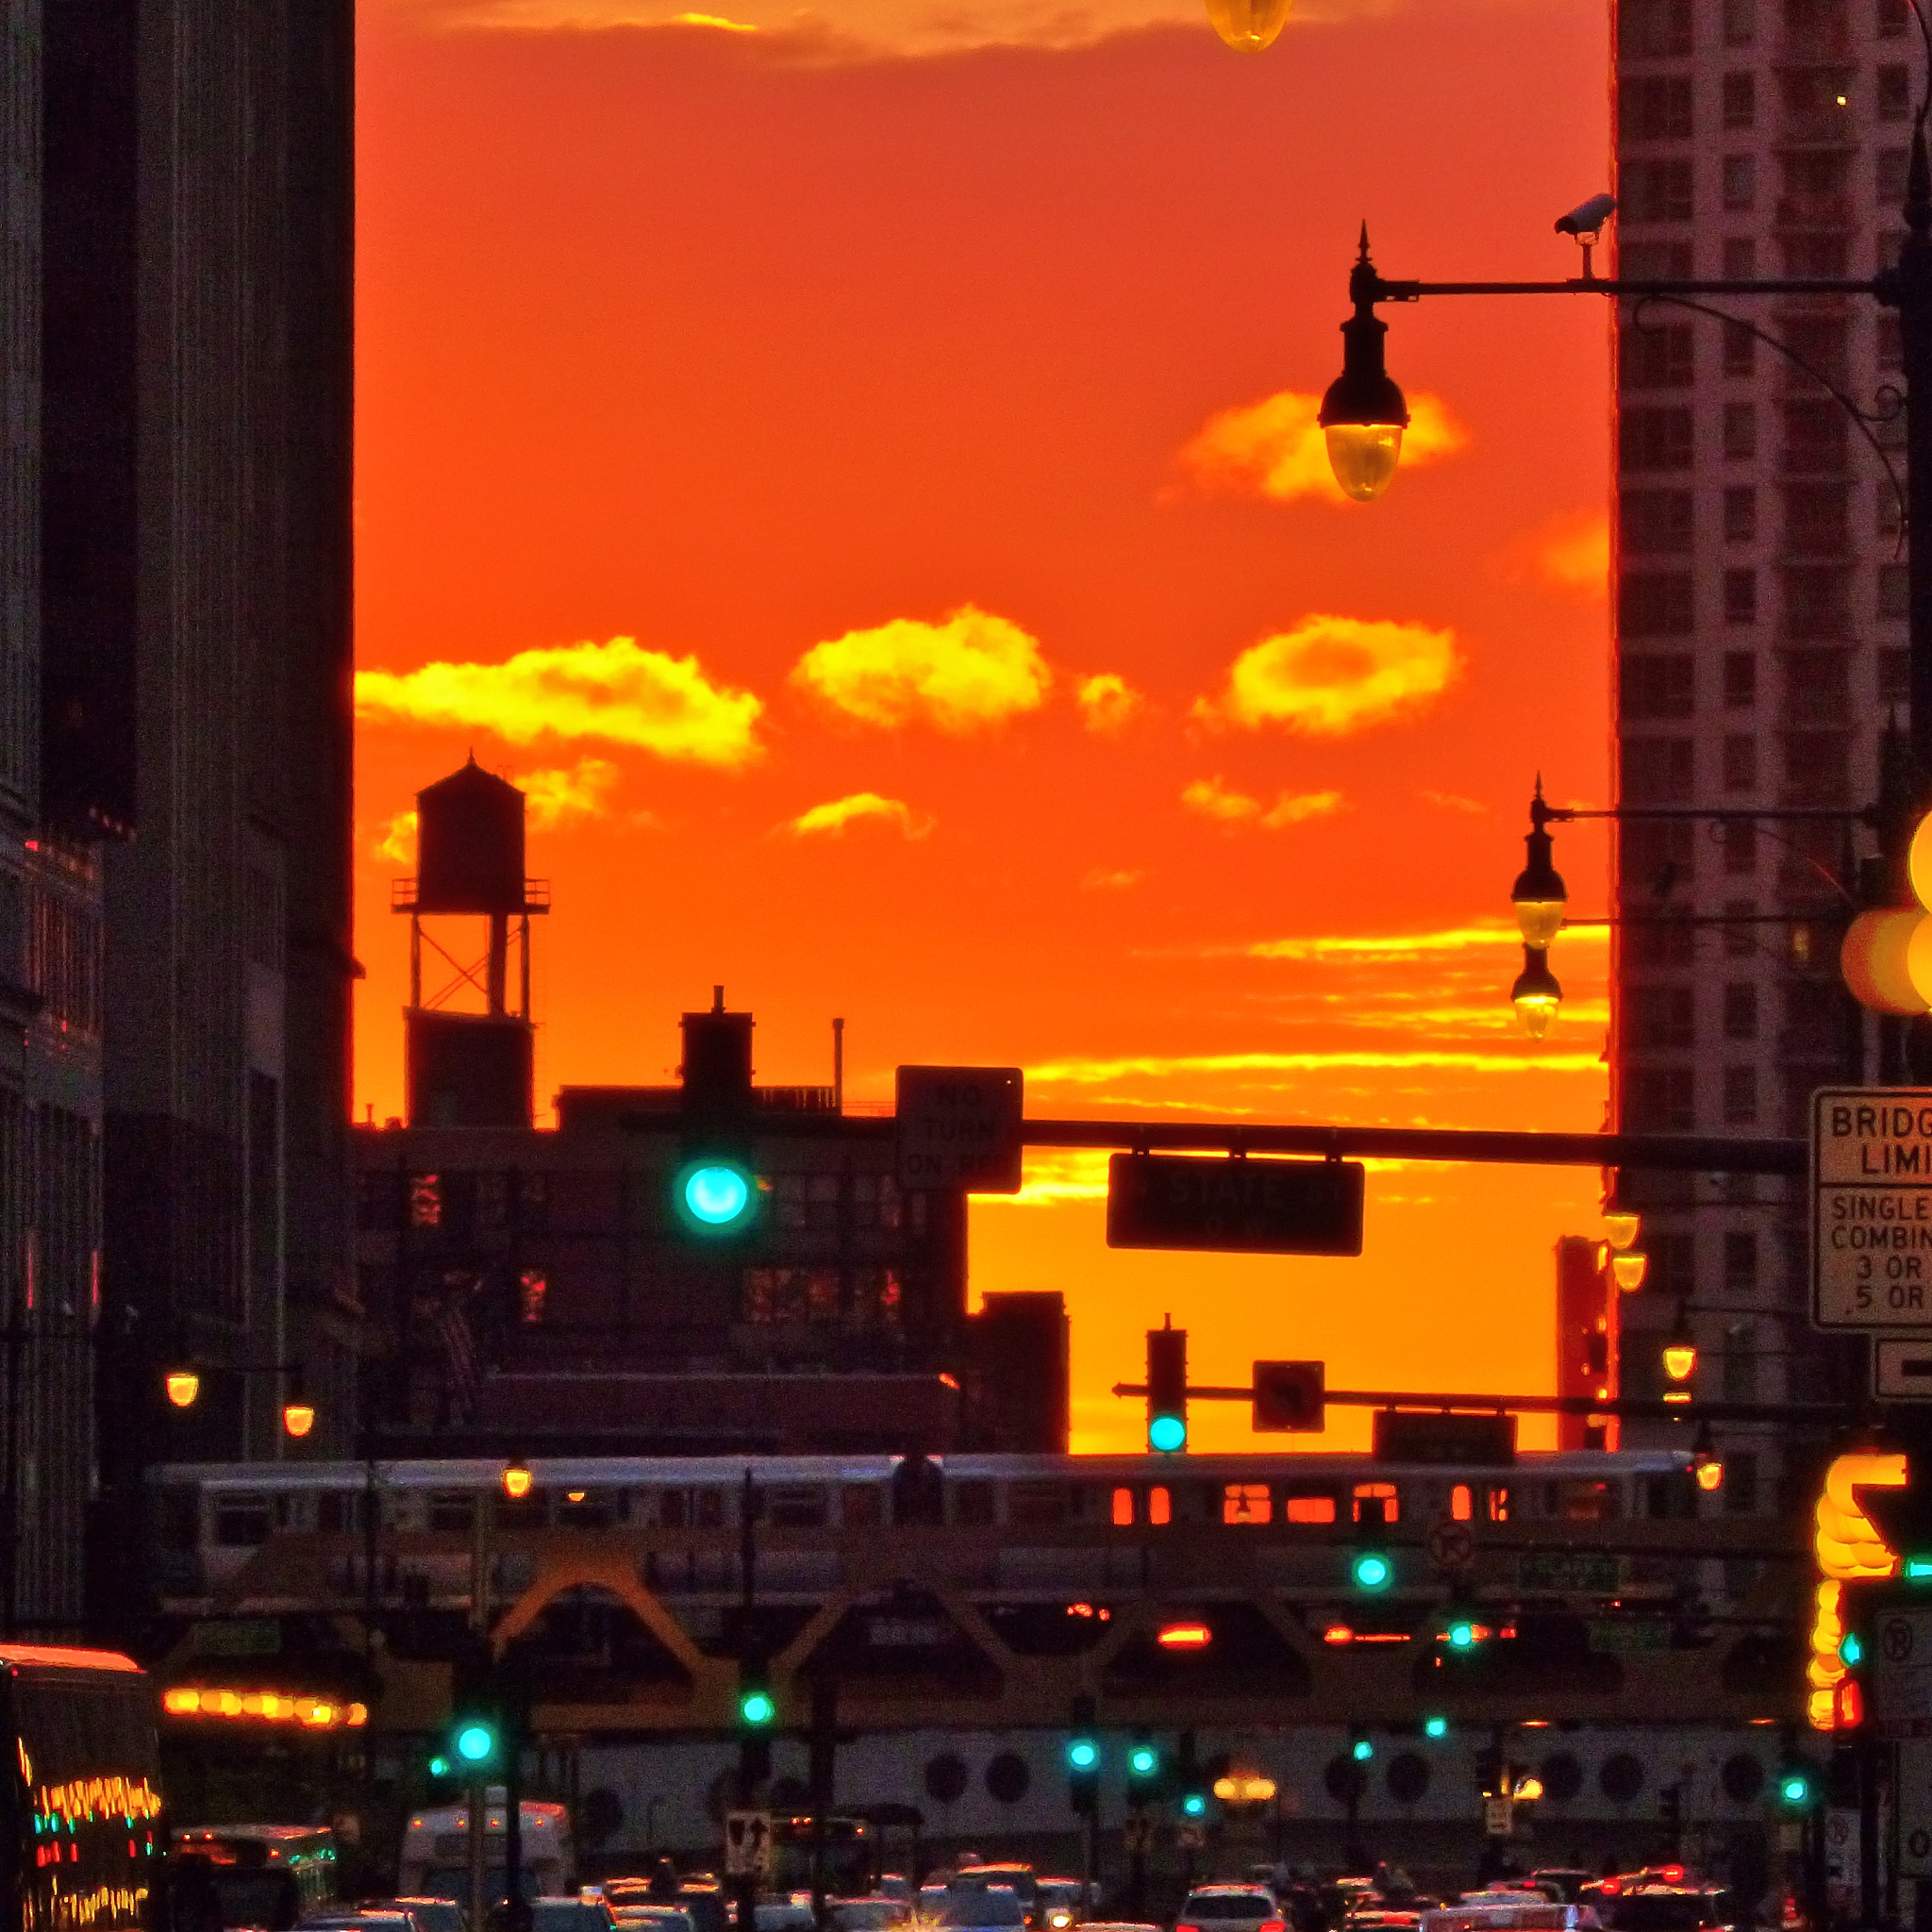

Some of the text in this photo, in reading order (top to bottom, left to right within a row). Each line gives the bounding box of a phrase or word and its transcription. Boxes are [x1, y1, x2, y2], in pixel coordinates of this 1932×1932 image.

[937, 1085, 982, 1107] NO
[924, 1118, 994, 1141] TURN
[1832, 1107, 1932, 1138] BRIDG
[908, 1154, 1008, 1176] ON RED
[1862, 1144, 1930, 1174] LIMI
[1168, 1171, 1286, 1208] STATE
[1833, 1195, 1930, 1220] SINGLE
[1832, 1225, 1932, 1249] COMBIN
[1857, 1256, 1922, 1279] 3 OR
[1856, 1285, 1924, 1308] 5 OR
